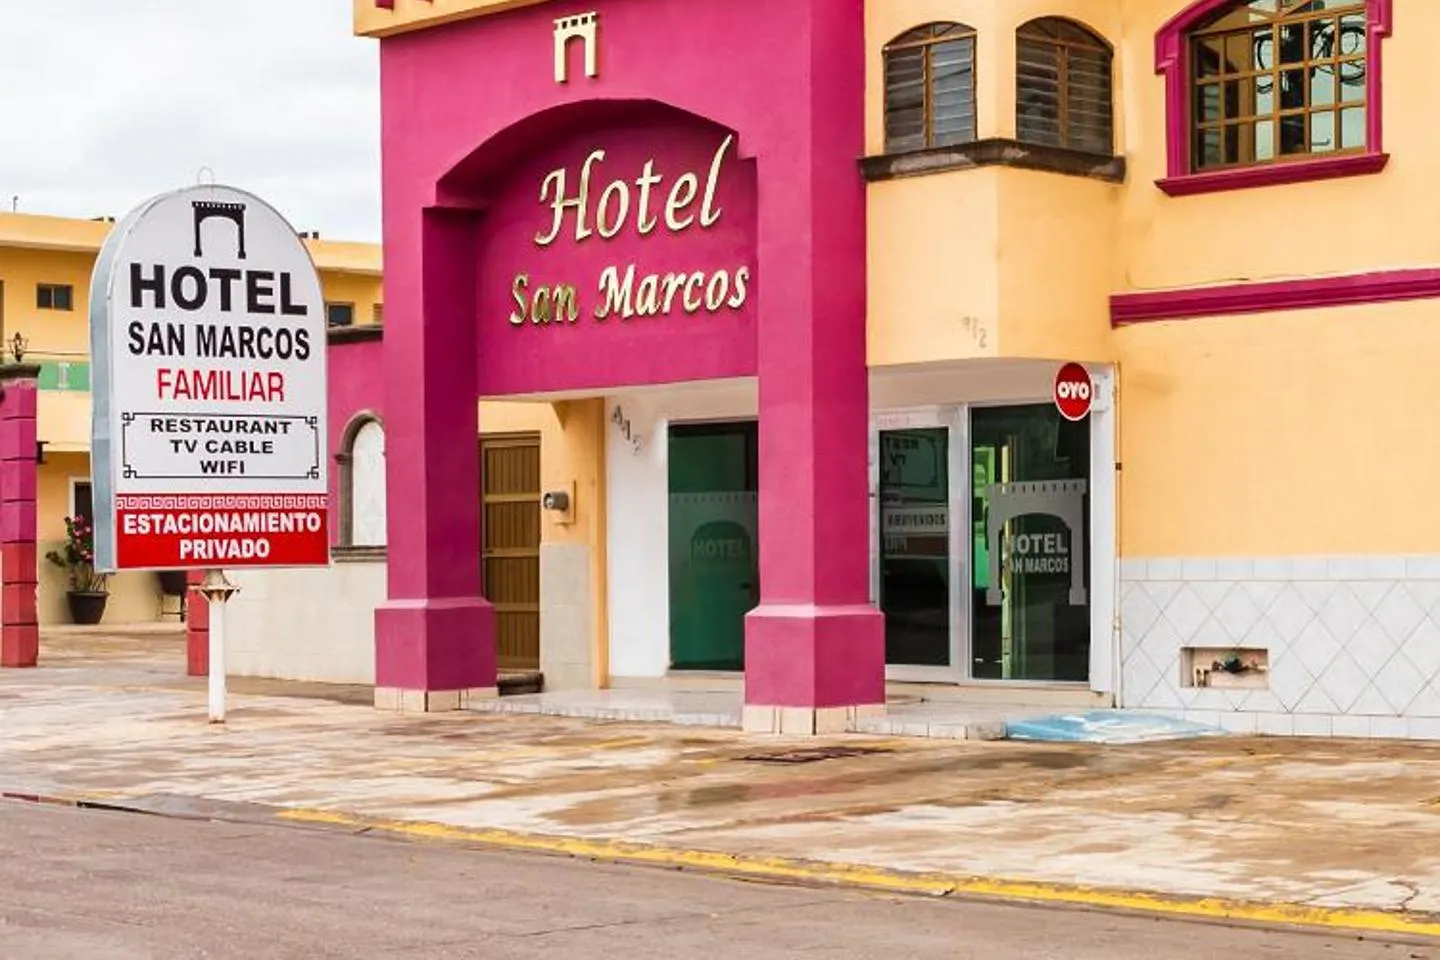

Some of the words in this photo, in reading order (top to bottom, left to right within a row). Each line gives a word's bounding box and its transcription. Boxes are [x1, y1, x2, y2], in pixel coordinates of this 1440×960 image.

[534, 134, 733, 246] Hotel
[129, 263, 308, 315] HOTEL
[509, 273, 580, 325] San
[594, 263, 751, 321] Marcos
[128, 321, 185, 355] SAN
[196, 324, 310, 360] MARCOS
[156, 368, 285, 402] FAMILIAR
[1057, 381, 1090, 400] OYO
[150, 419, 292, 434] RESTAURANT
[170, 440, 198, 454] TV
[205, 440, 274, 454] CABLE
[200, 460, 245, 474] WIFI
[124, 513, 321, 535] ESTACIONAMIENTO
[180, 539, 270, 560] PRIVADO
[1025, 557, 1069, 573] MARCOS
